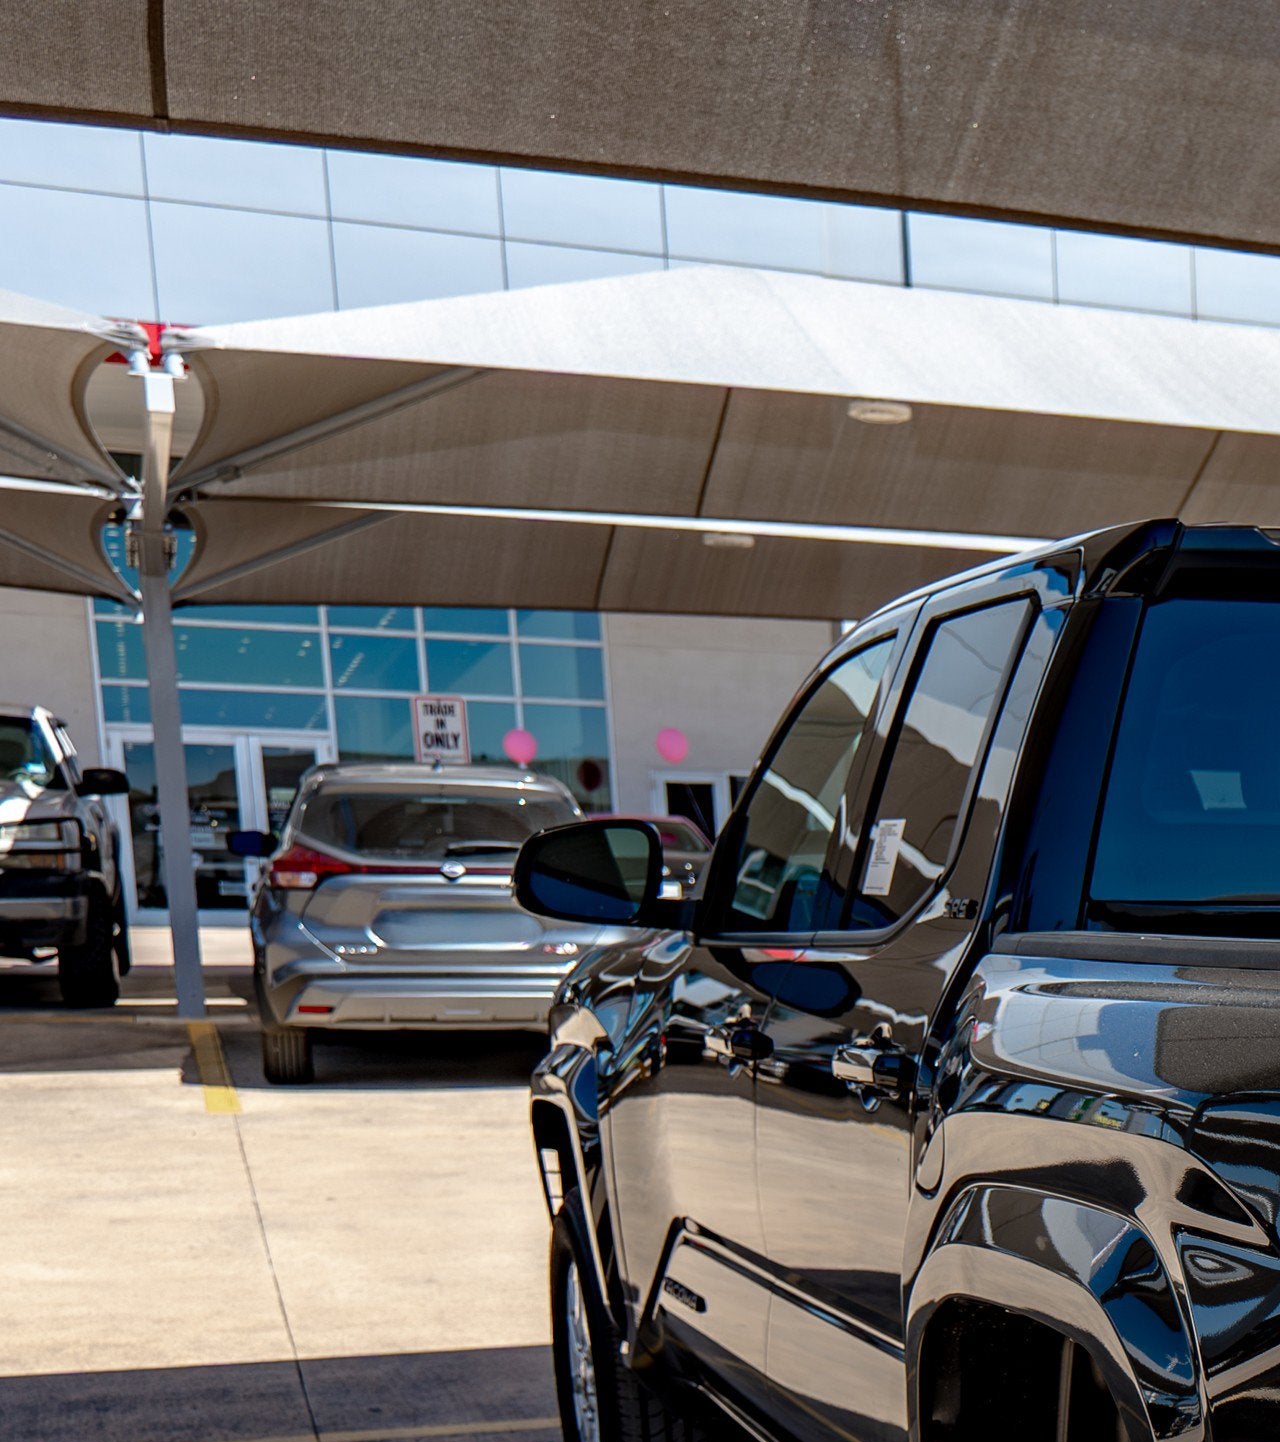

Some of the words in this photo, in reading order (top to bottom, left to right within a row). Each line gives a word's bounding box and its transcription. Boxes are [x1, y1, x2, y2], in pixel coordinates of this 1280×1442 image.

[422, 703, 455, 717] TRADE
[435, 718, 447, 729] IN
[423, 732, 460, 750] ONLY
